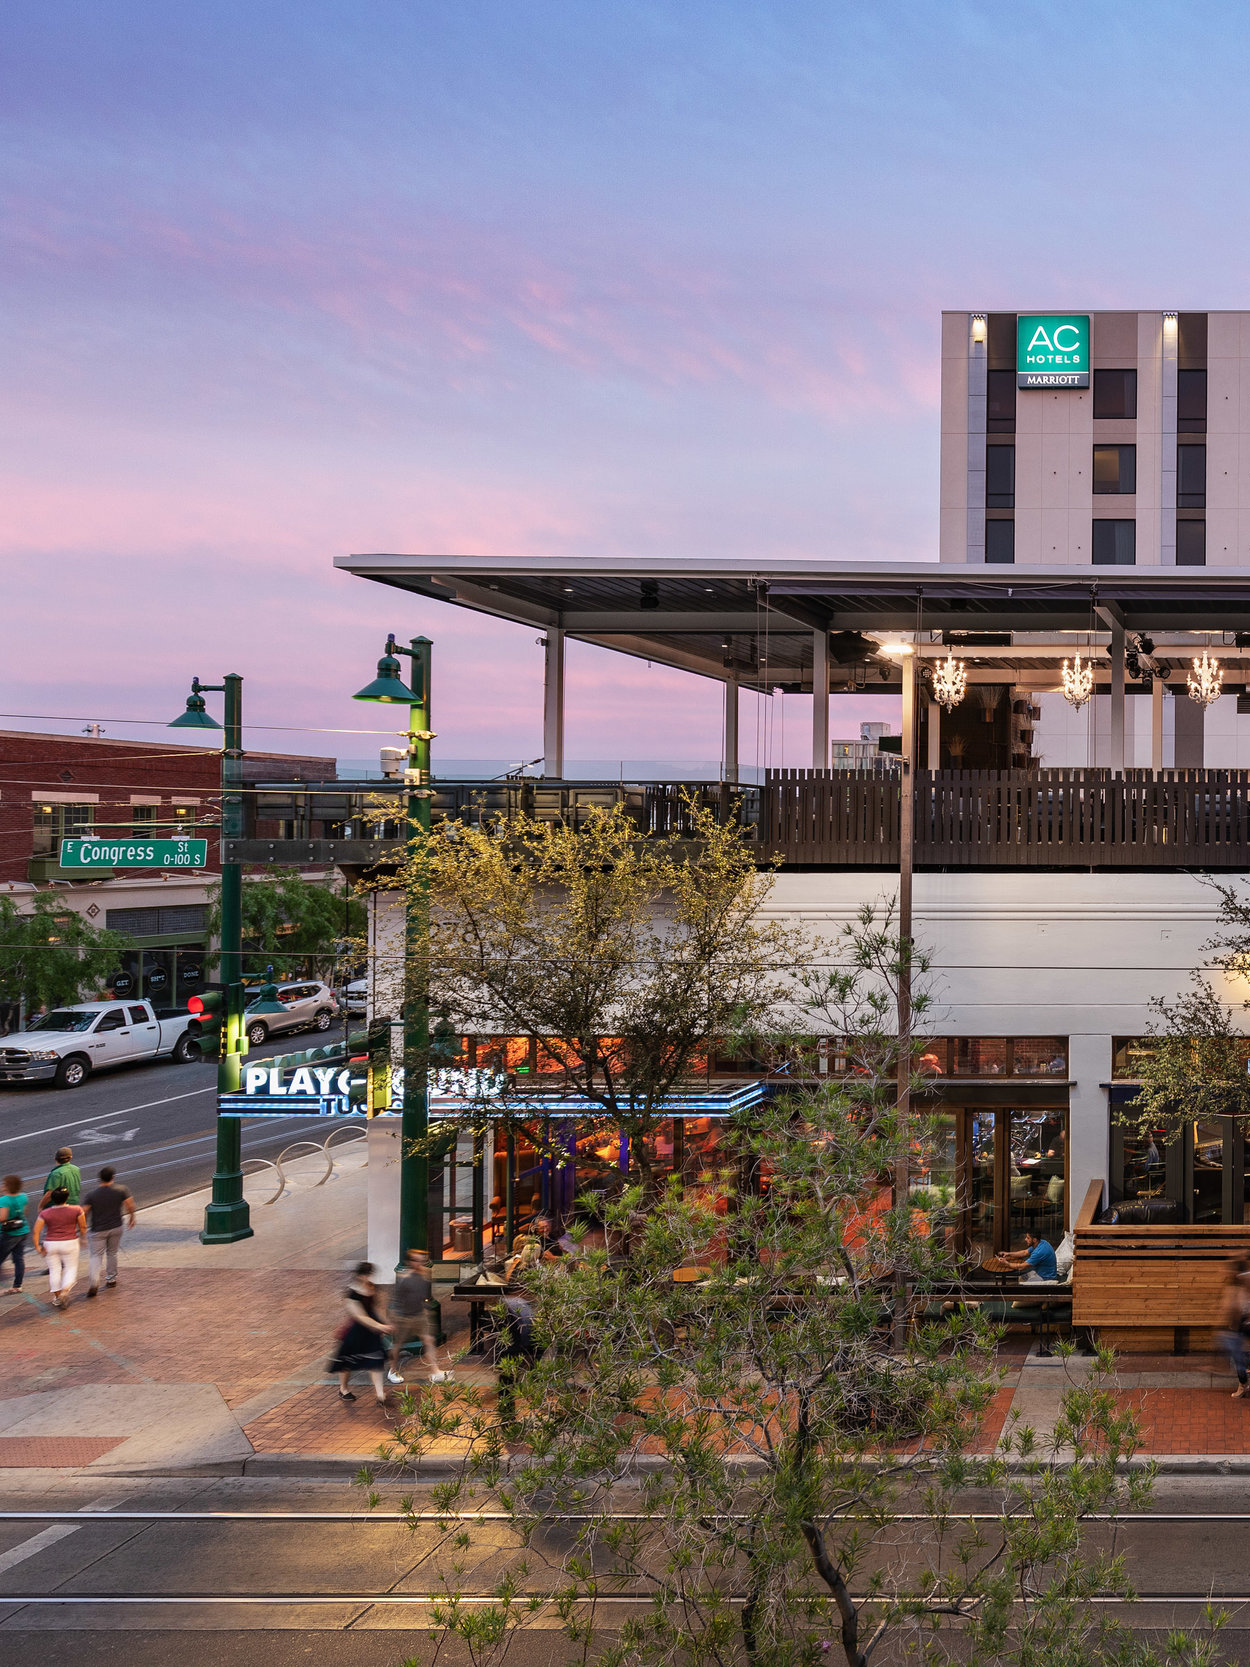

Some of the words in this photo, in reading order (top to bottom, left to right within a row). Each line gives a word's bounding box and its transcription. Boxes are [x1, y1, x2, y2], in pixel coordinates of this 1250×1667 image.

[1027, 324, 1080, 352] AC
[1026, 354, 1080, 364] HOTELS
[1026, 375, 1080, 385] MARRIOTT
[67, 842, 74, 852] E
[80, 843, 154, 865] Congress
[177, 841, 188, 852] St
[163, 853, 191, 865] 0-100
[194, 853, 201, 865] S
